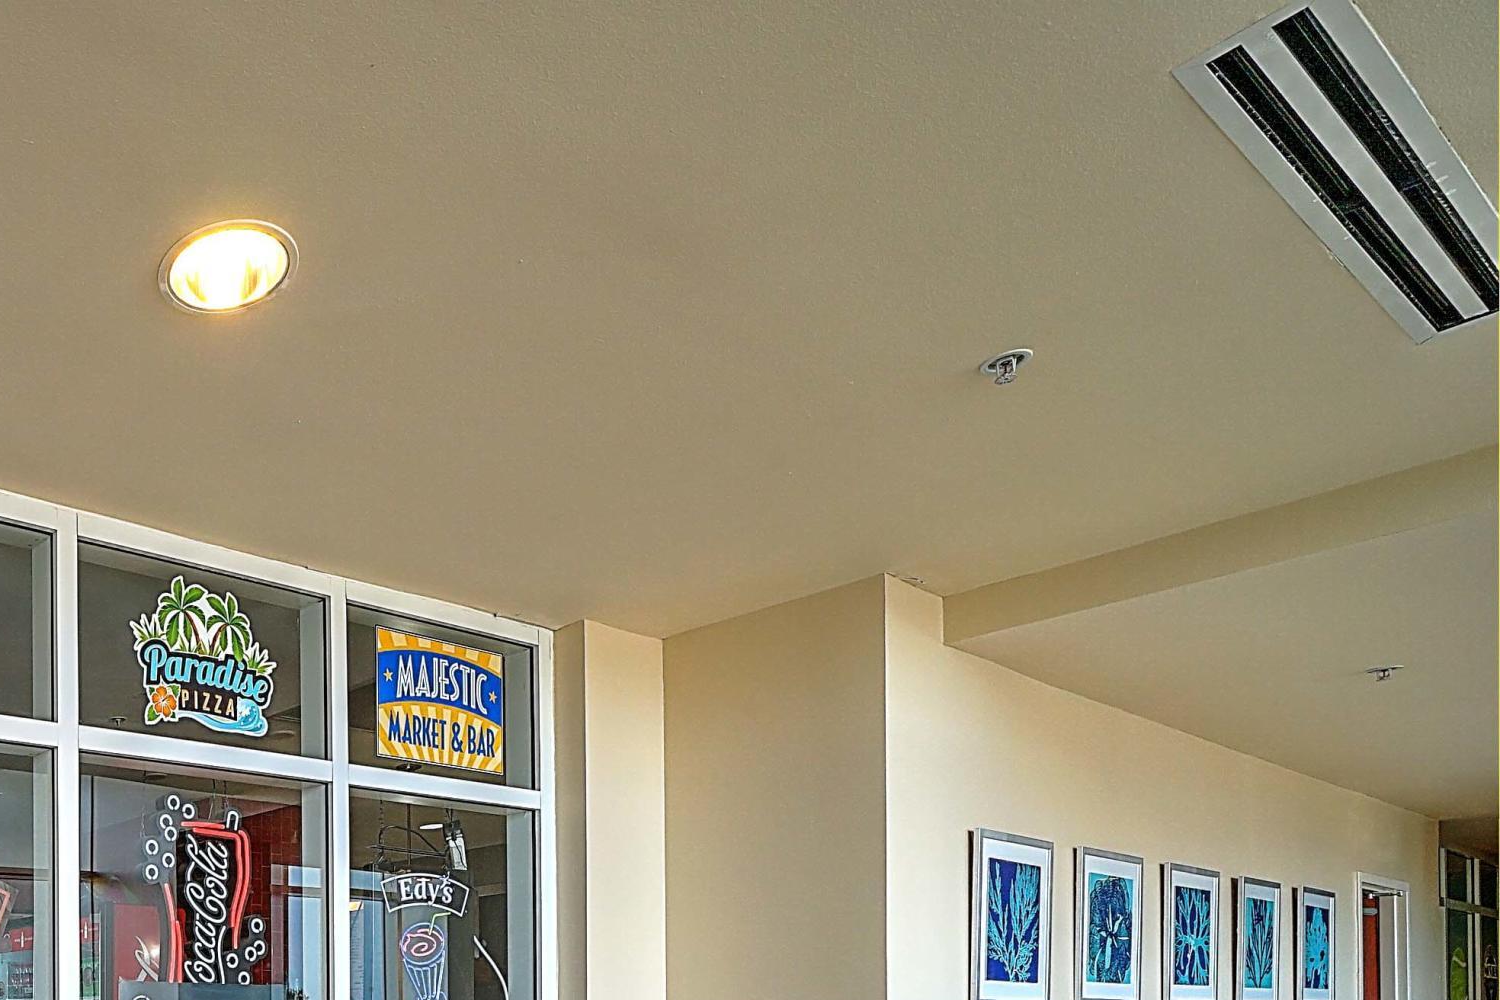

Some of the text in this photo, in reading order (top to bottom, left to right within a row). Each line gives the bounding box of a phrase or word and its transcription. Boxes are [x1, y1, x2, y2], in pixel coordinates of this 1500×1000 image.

[144, 643, 269, 701] Paradise
[397, 654, 488, 715] MAJESTIC
[181, 687, 236, 716] PIZZA
[388, 715, 496, 758] MARKET & BAR
[398, 876, 454, 906] Edy's
